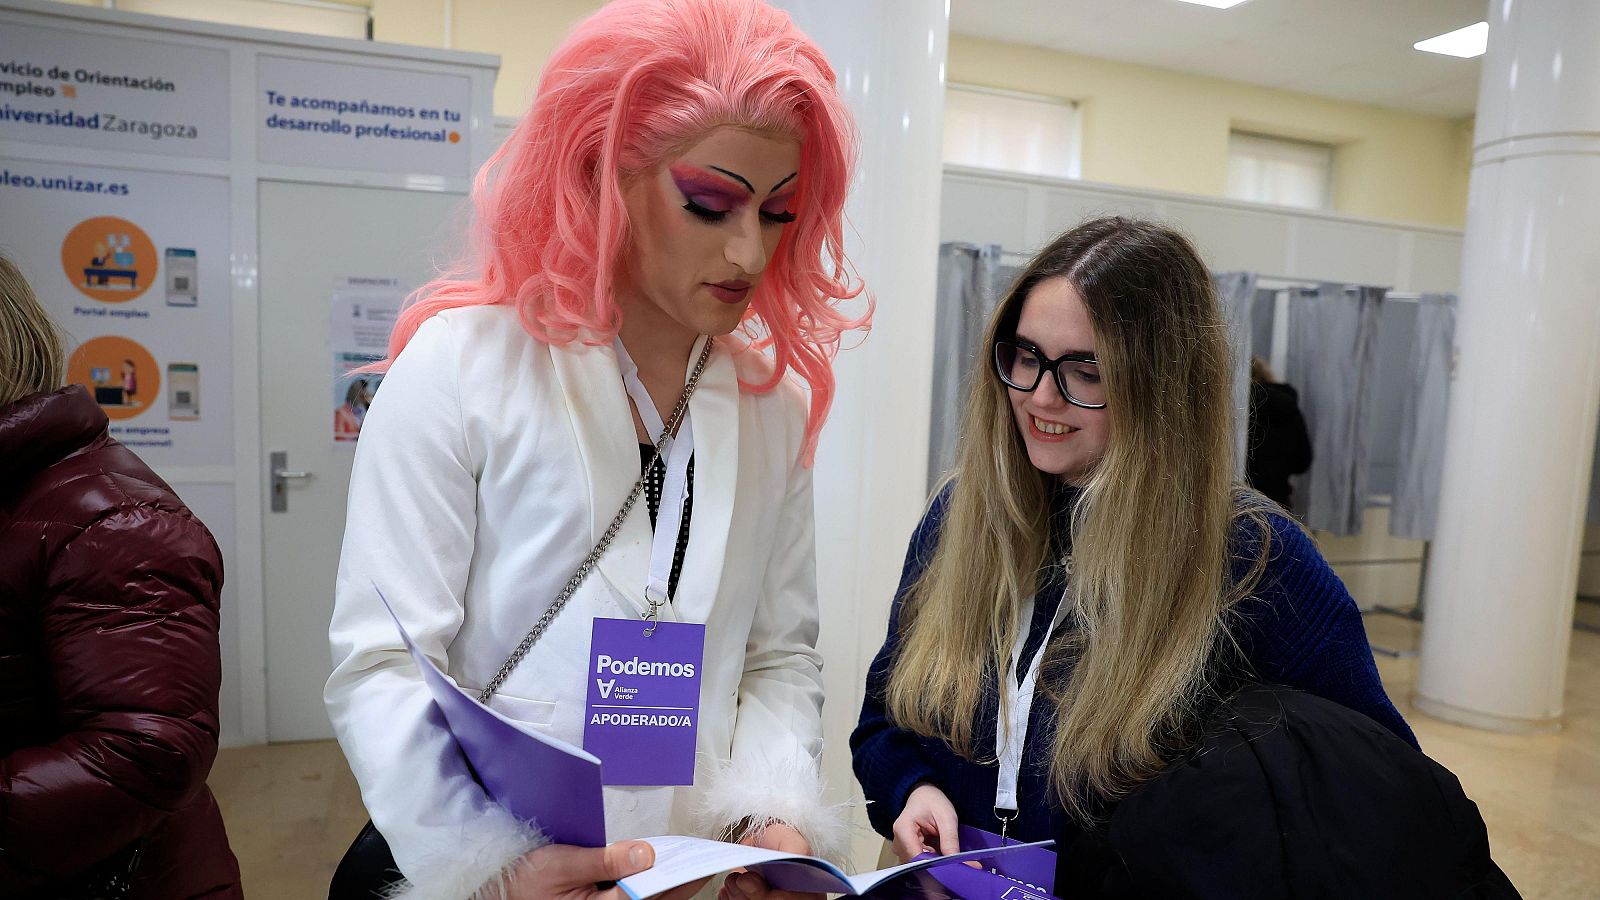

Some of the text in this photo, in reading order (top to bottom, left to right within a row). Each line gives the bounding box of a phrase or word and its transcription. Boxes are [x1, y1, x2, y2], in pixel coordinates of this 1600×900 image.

[47, 66, 70, 81] de
[74, 69, 175, 92] Orientación
[267, 91, 460, 122] Te acompañamos en tu
[102, 114, 198, 139] Zaragoza
[266, 114, 446, 142] desarrollo profesional
[0, 169, 129, 196] leo.unizar.es
[596, 654, 695, 678] Podemos
[614, 686, 638, 694] Alianza
[590, 713, 692, 727] APODERADO/A
